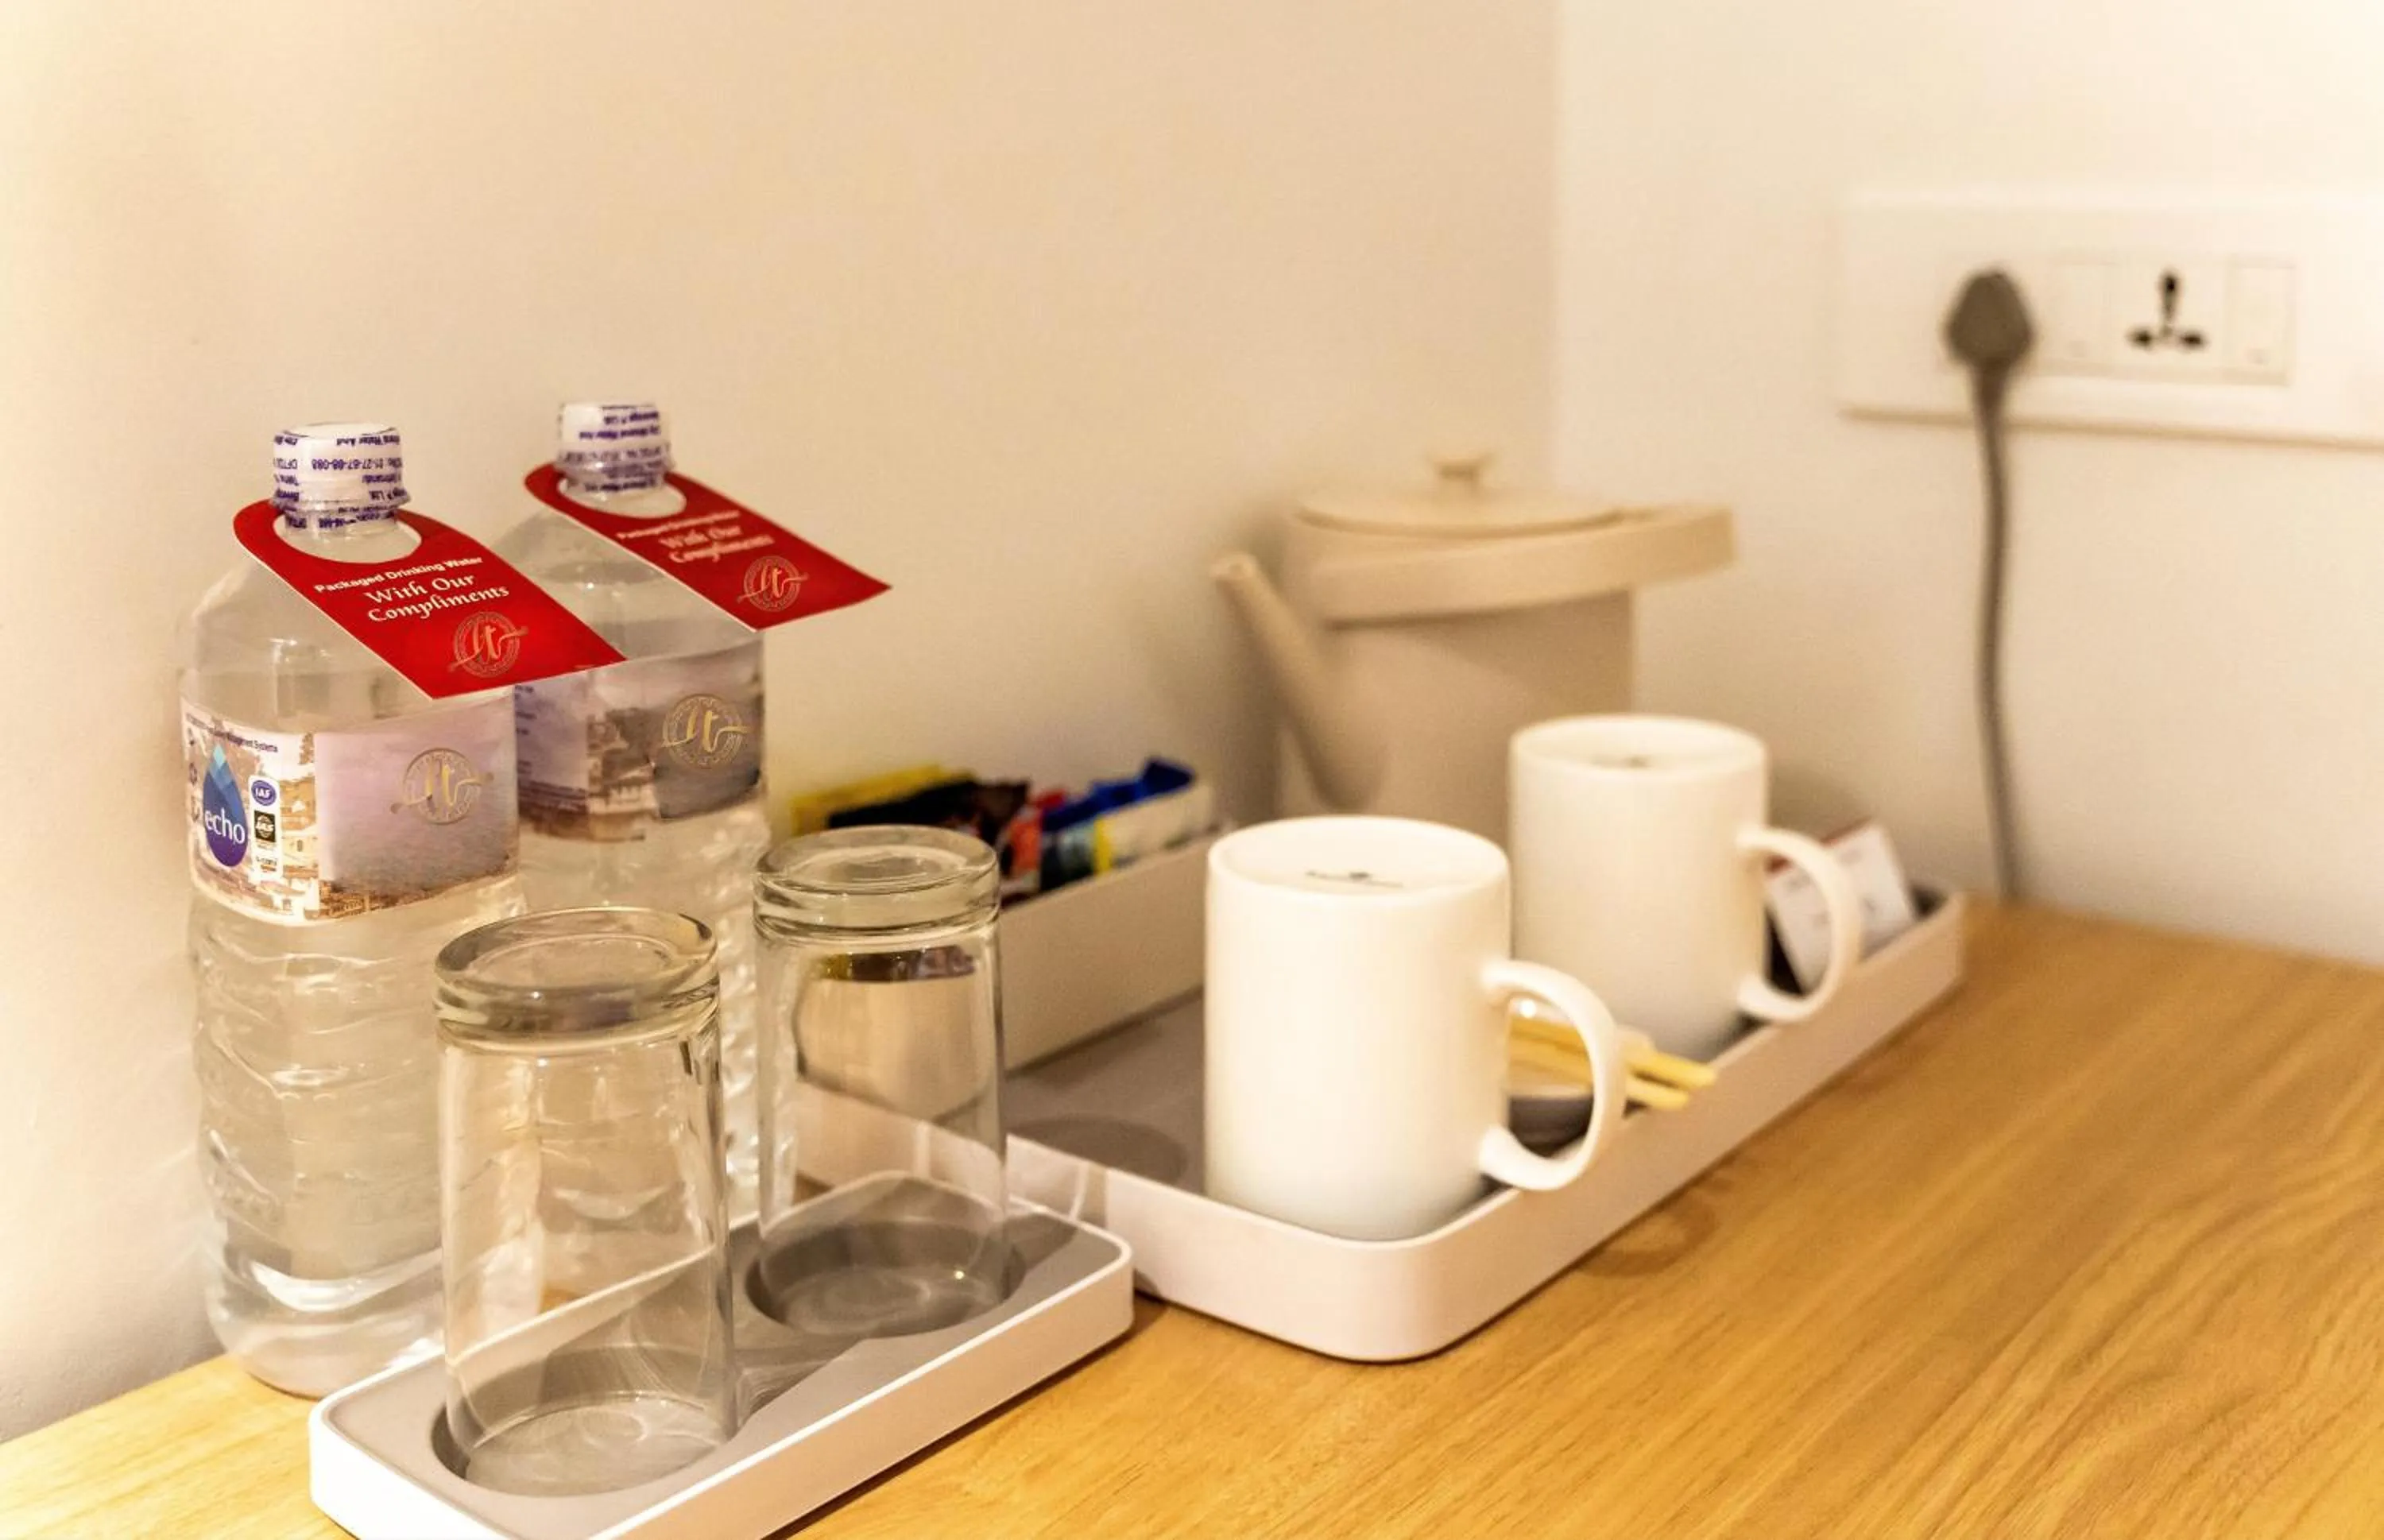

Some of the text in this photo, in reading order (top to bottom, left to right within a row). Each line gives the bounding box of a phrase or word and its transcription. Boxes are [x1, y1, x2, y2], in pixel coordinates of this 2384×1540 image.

[314, 556, 483, 594] Packaged Drinking Water
[362, 575, 475, 605] With Our
[368, 585, 509, 621] Compliments
[205, 807, 246, 845] echo
